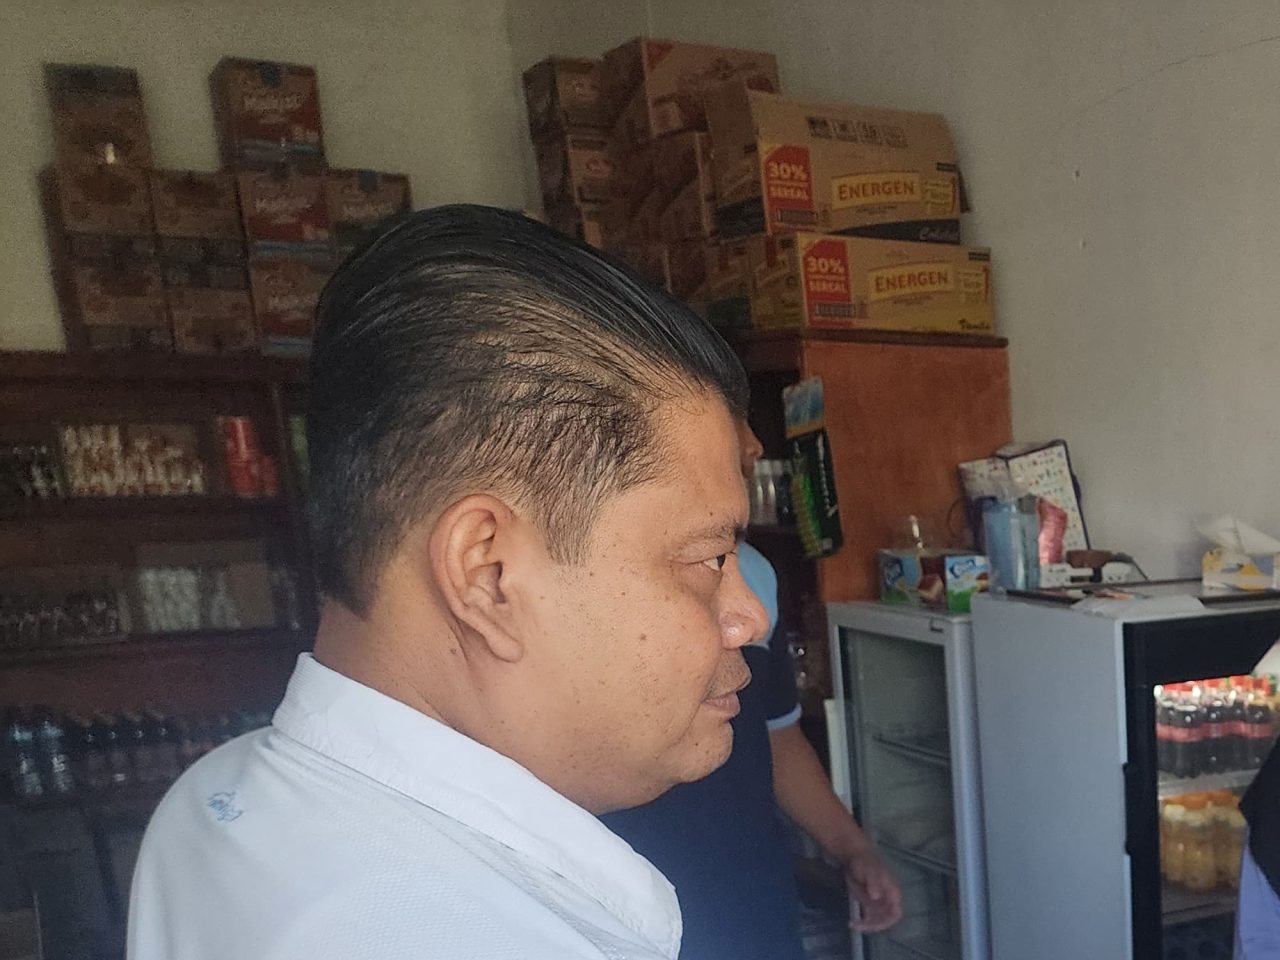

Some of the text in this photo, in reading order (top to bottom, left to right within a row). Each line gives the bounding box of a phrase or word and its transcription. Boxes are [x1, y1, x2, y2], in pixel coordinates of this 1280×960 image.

[768, 161, 808, 181] 30%
[838, 180, 915, 201] ENERGEN
[806, 256, 846, 274] 30%
[874, 271, 948, 293] ENERGEN
